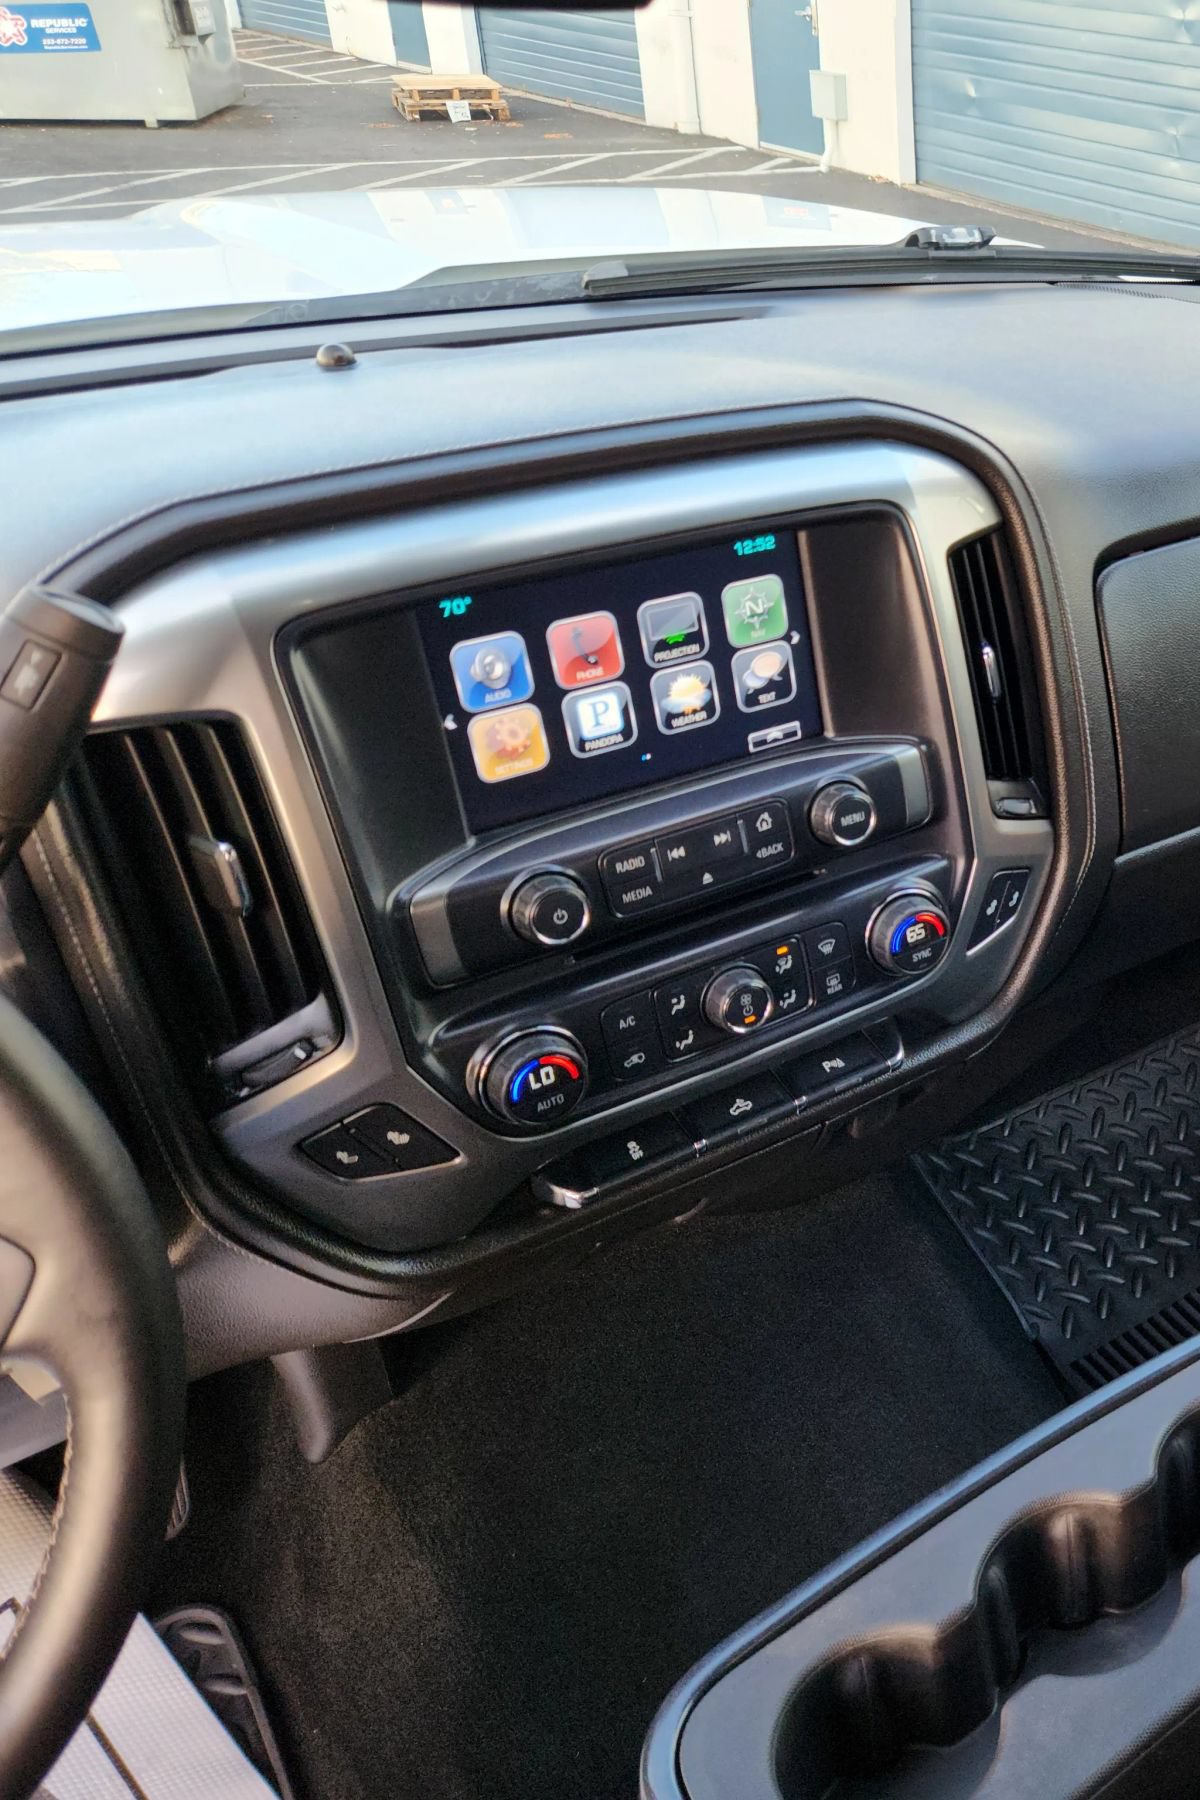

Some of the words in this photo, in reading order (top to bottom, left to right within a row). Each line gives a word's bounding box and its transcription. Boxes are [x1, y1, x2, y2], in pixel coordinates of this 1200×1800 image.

[31, 18, 87, 28] REPUBLIC
[734, 534, 776, 556] 12:52
[654, 643, 700, 662] PROJECTION
[576, 667, 604, 681] PHONE
[485, 689, 512, 703] AUDIO
[758, 691, 776, 704] TEXT
[671, 711, 708, 728] WEATHER
[584, 733, 624, 751] PANDORA
[840, 812, 865, 827] MENU
[762, 842, 784, 858] BACK
[615, 856, 646, 874] RADIO
[622, 886, 653, 904] MEDIA
[906, 923, 926, 943] 65
[912, 948, 932, 962] SYNC
[827, 983, 843, 995] REAR
[619, 1015, 636, 1030] A/C
[537, 1094, 565, 1113] AUTO
